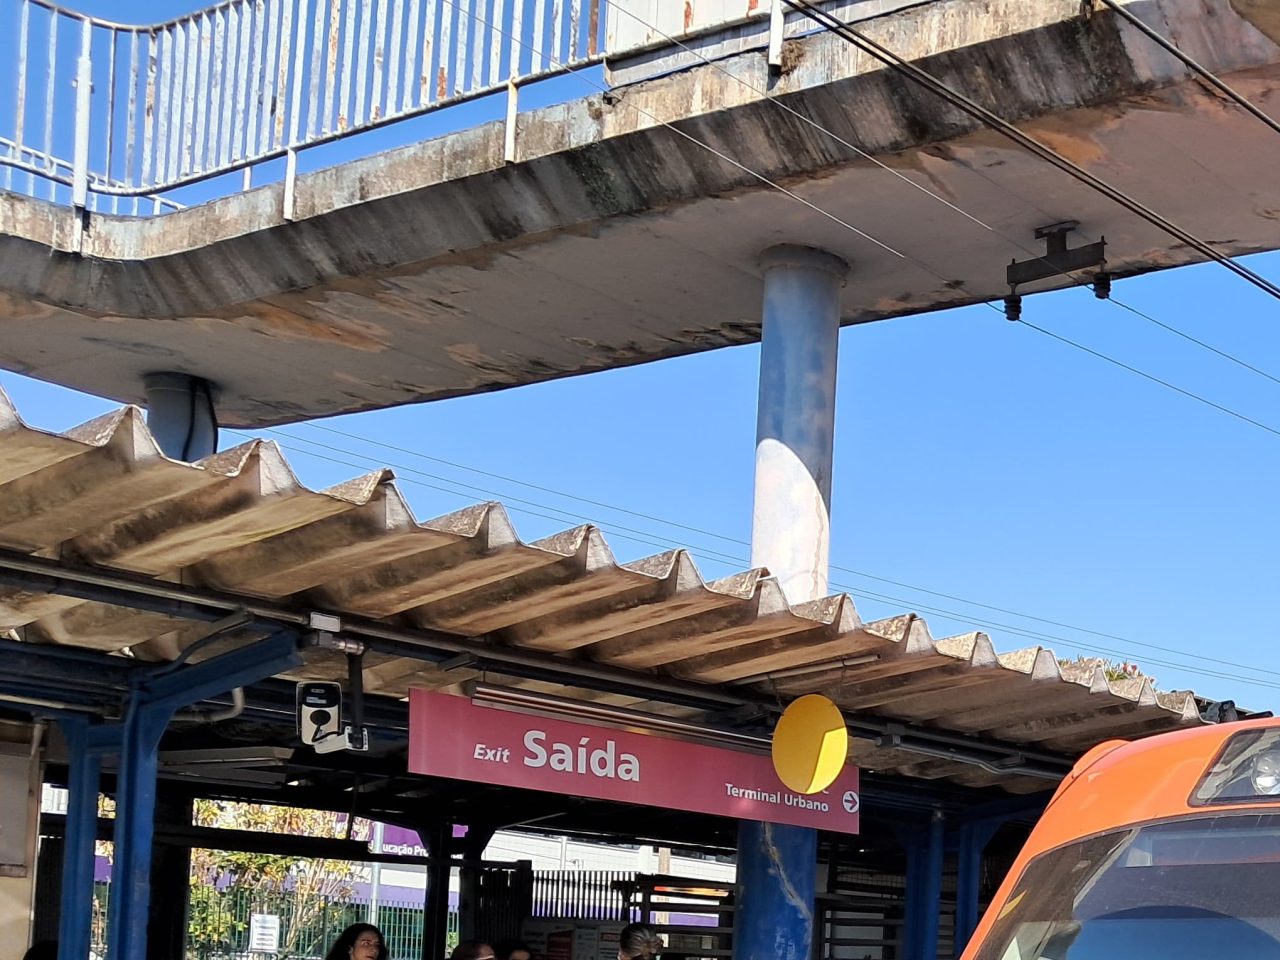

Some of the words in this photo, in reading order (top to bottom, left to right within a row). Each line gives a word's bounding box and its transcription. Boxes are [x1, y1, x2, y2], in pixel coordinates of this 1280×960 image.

[473, 743, 511, 764] Exit
[523, 729, 641, 782] Saída
[725, 783, 781, 804] Terminal
[784, 793, 829, 812] Urbano
